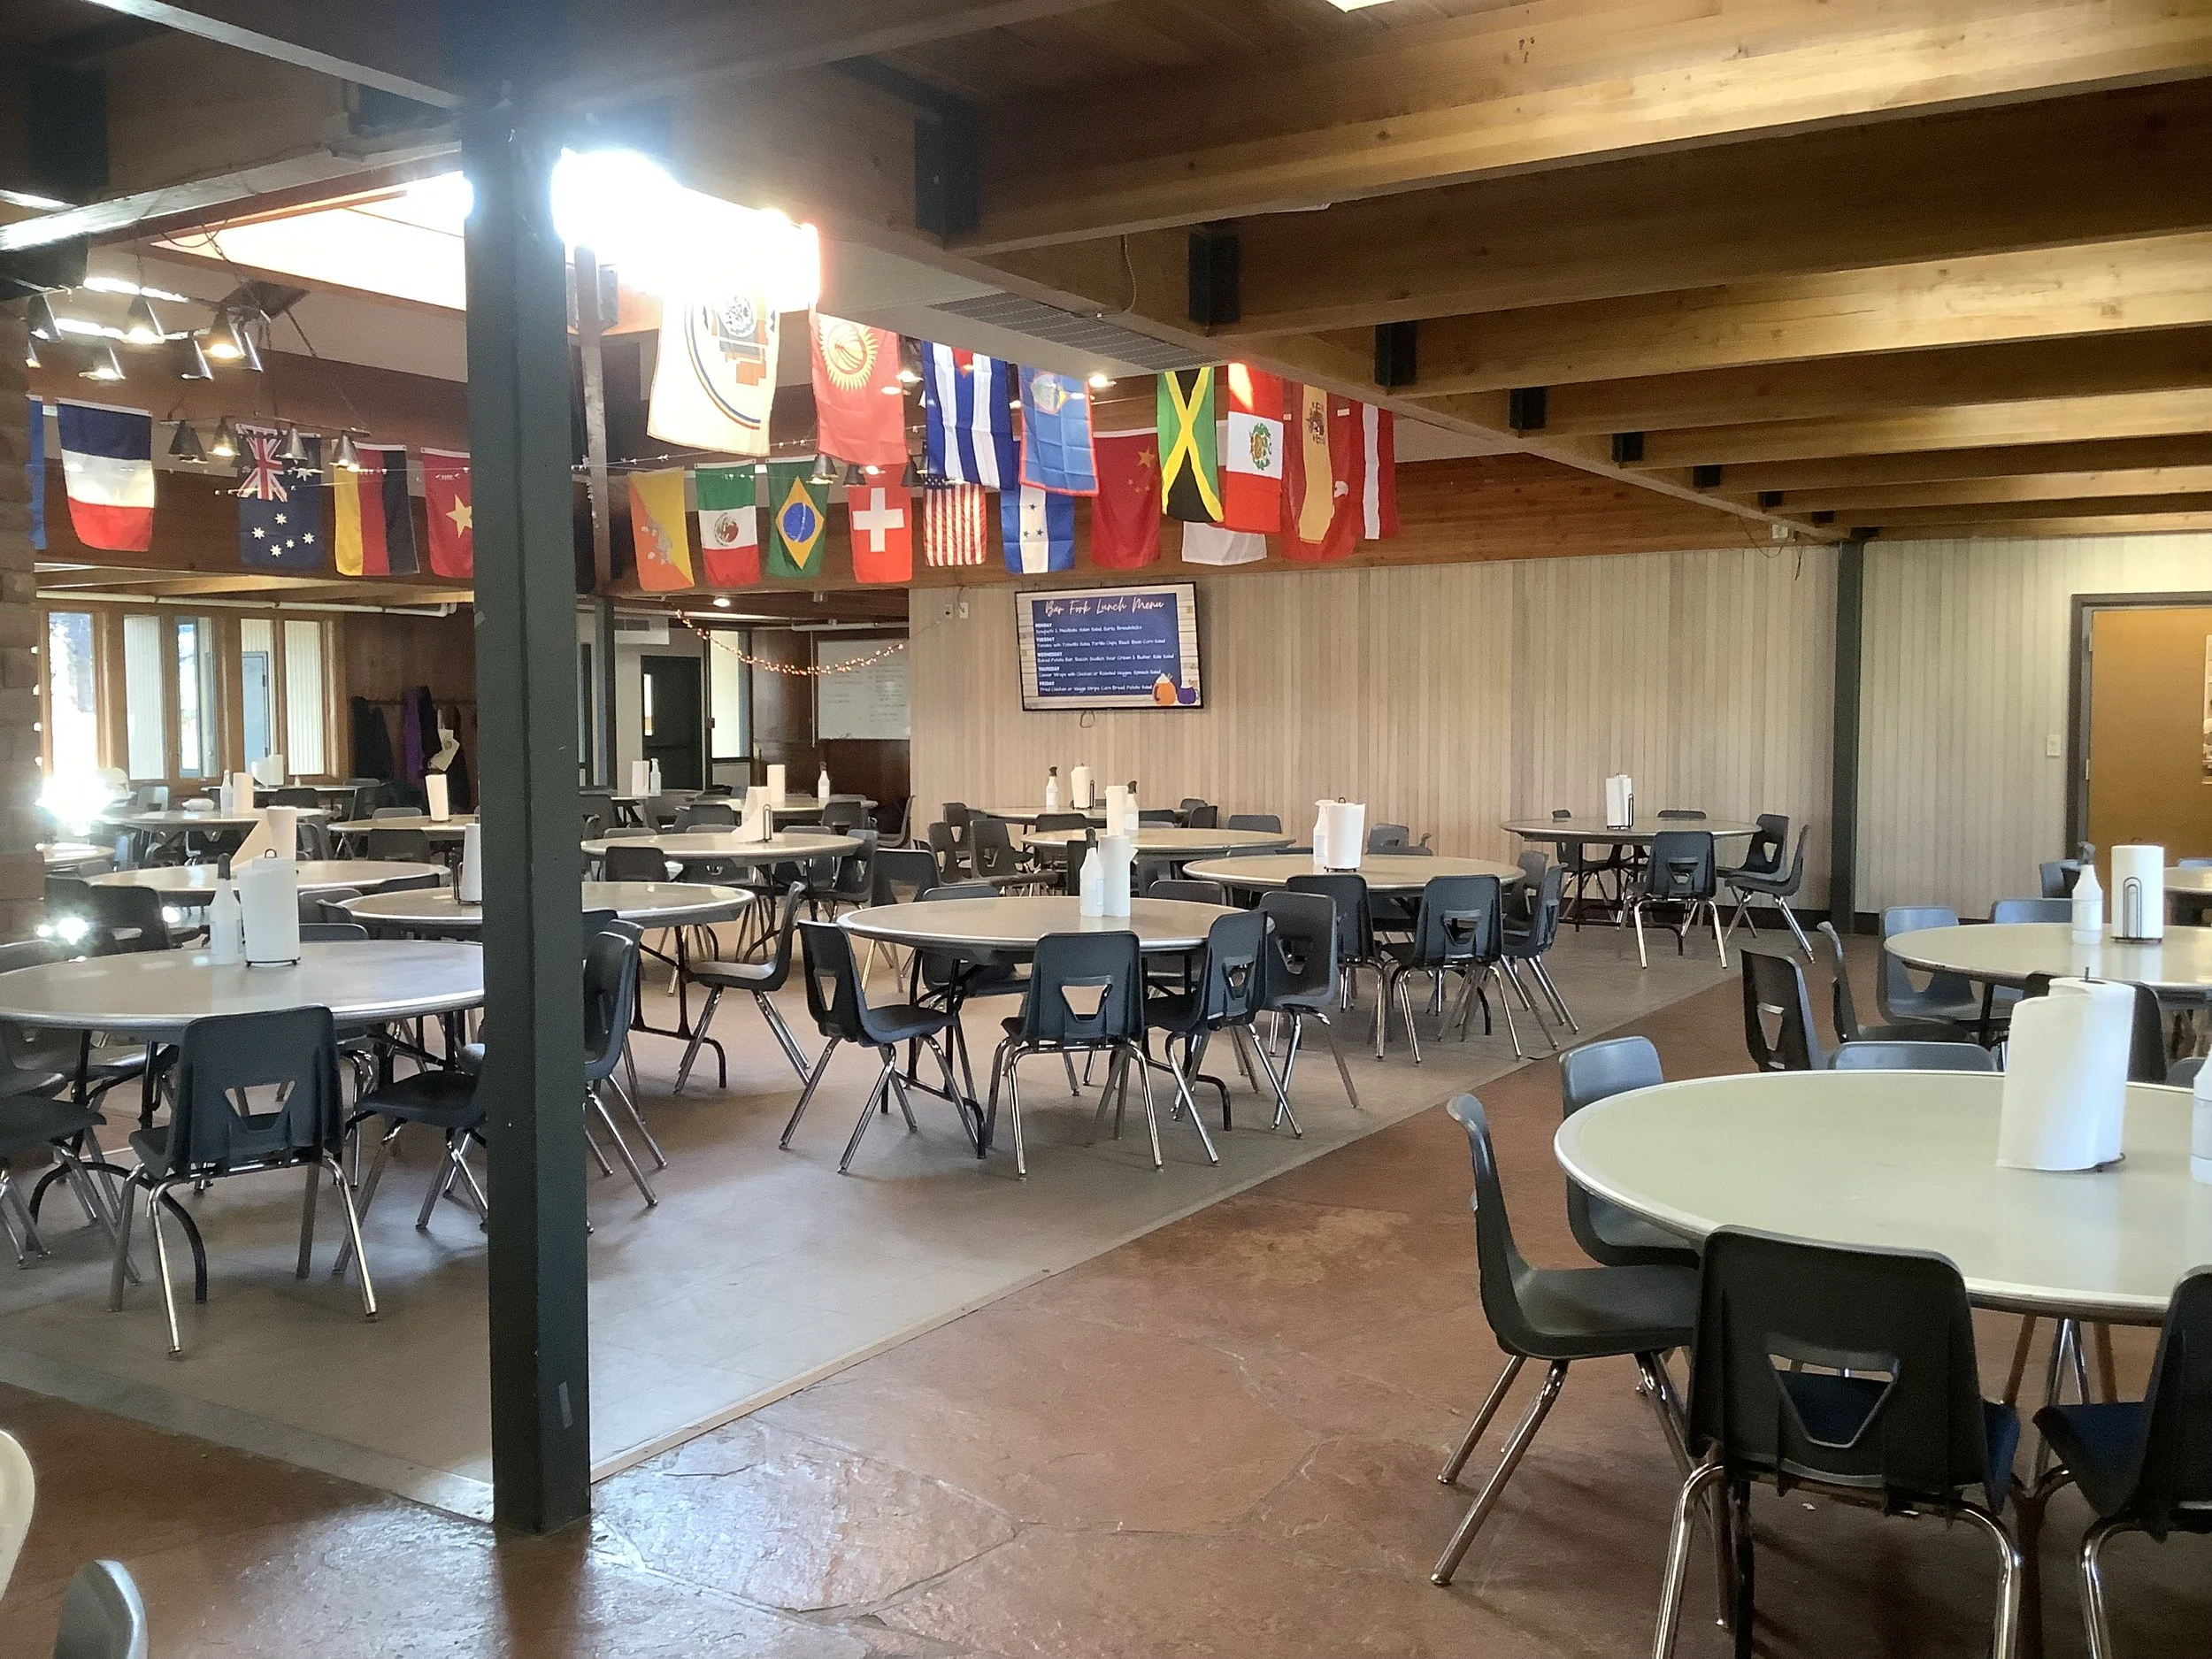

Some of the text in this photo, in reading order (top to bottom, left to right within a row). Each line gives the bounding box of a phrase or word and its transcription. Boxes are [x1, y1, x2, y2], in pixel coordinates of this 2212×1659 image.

[1045, 596, 1164, 617] Bar Fork Lunch Menu
